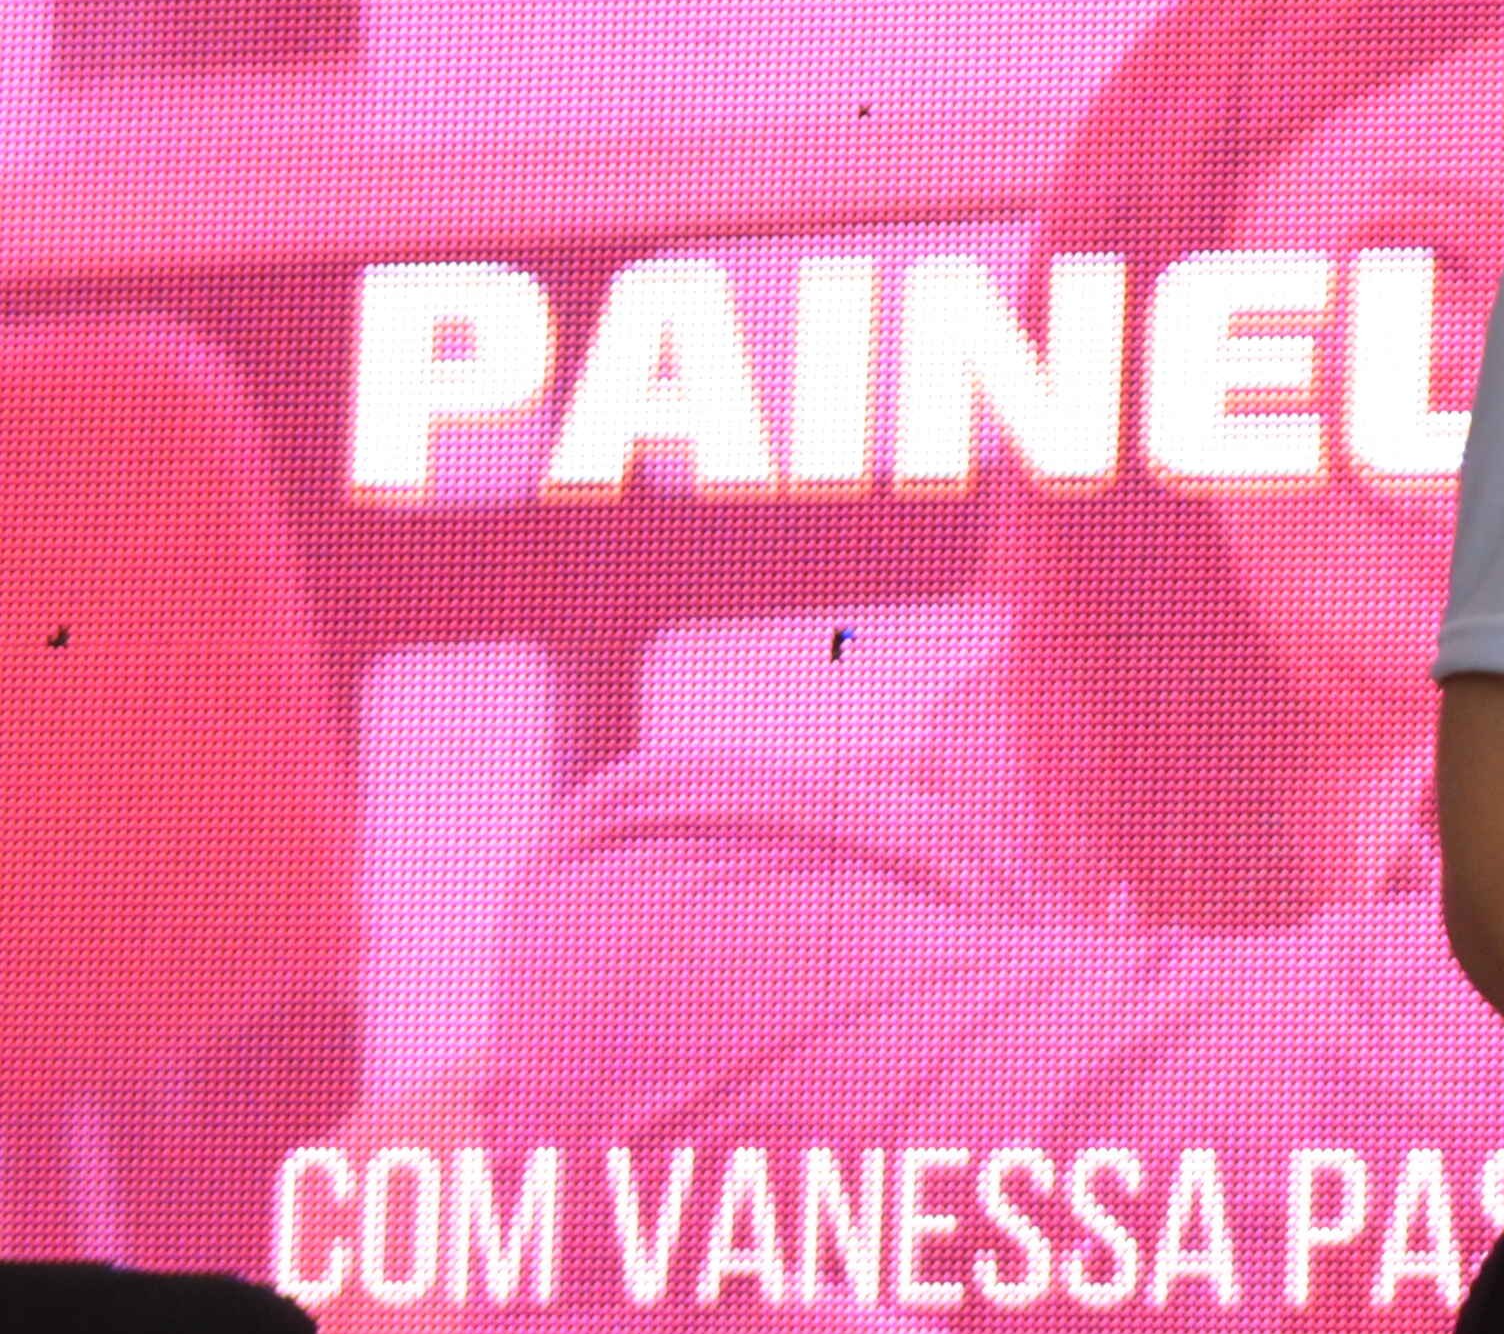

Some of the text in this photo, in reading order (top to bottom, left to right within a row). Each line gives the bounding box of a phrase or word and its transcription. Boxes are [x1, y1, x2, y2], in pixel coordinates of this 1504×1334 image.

[349, 247, 1473, 496] PAINEL
[273, 1145, 562, 1309] COM
[604, 1144, 1240, 1310] VANESSA
